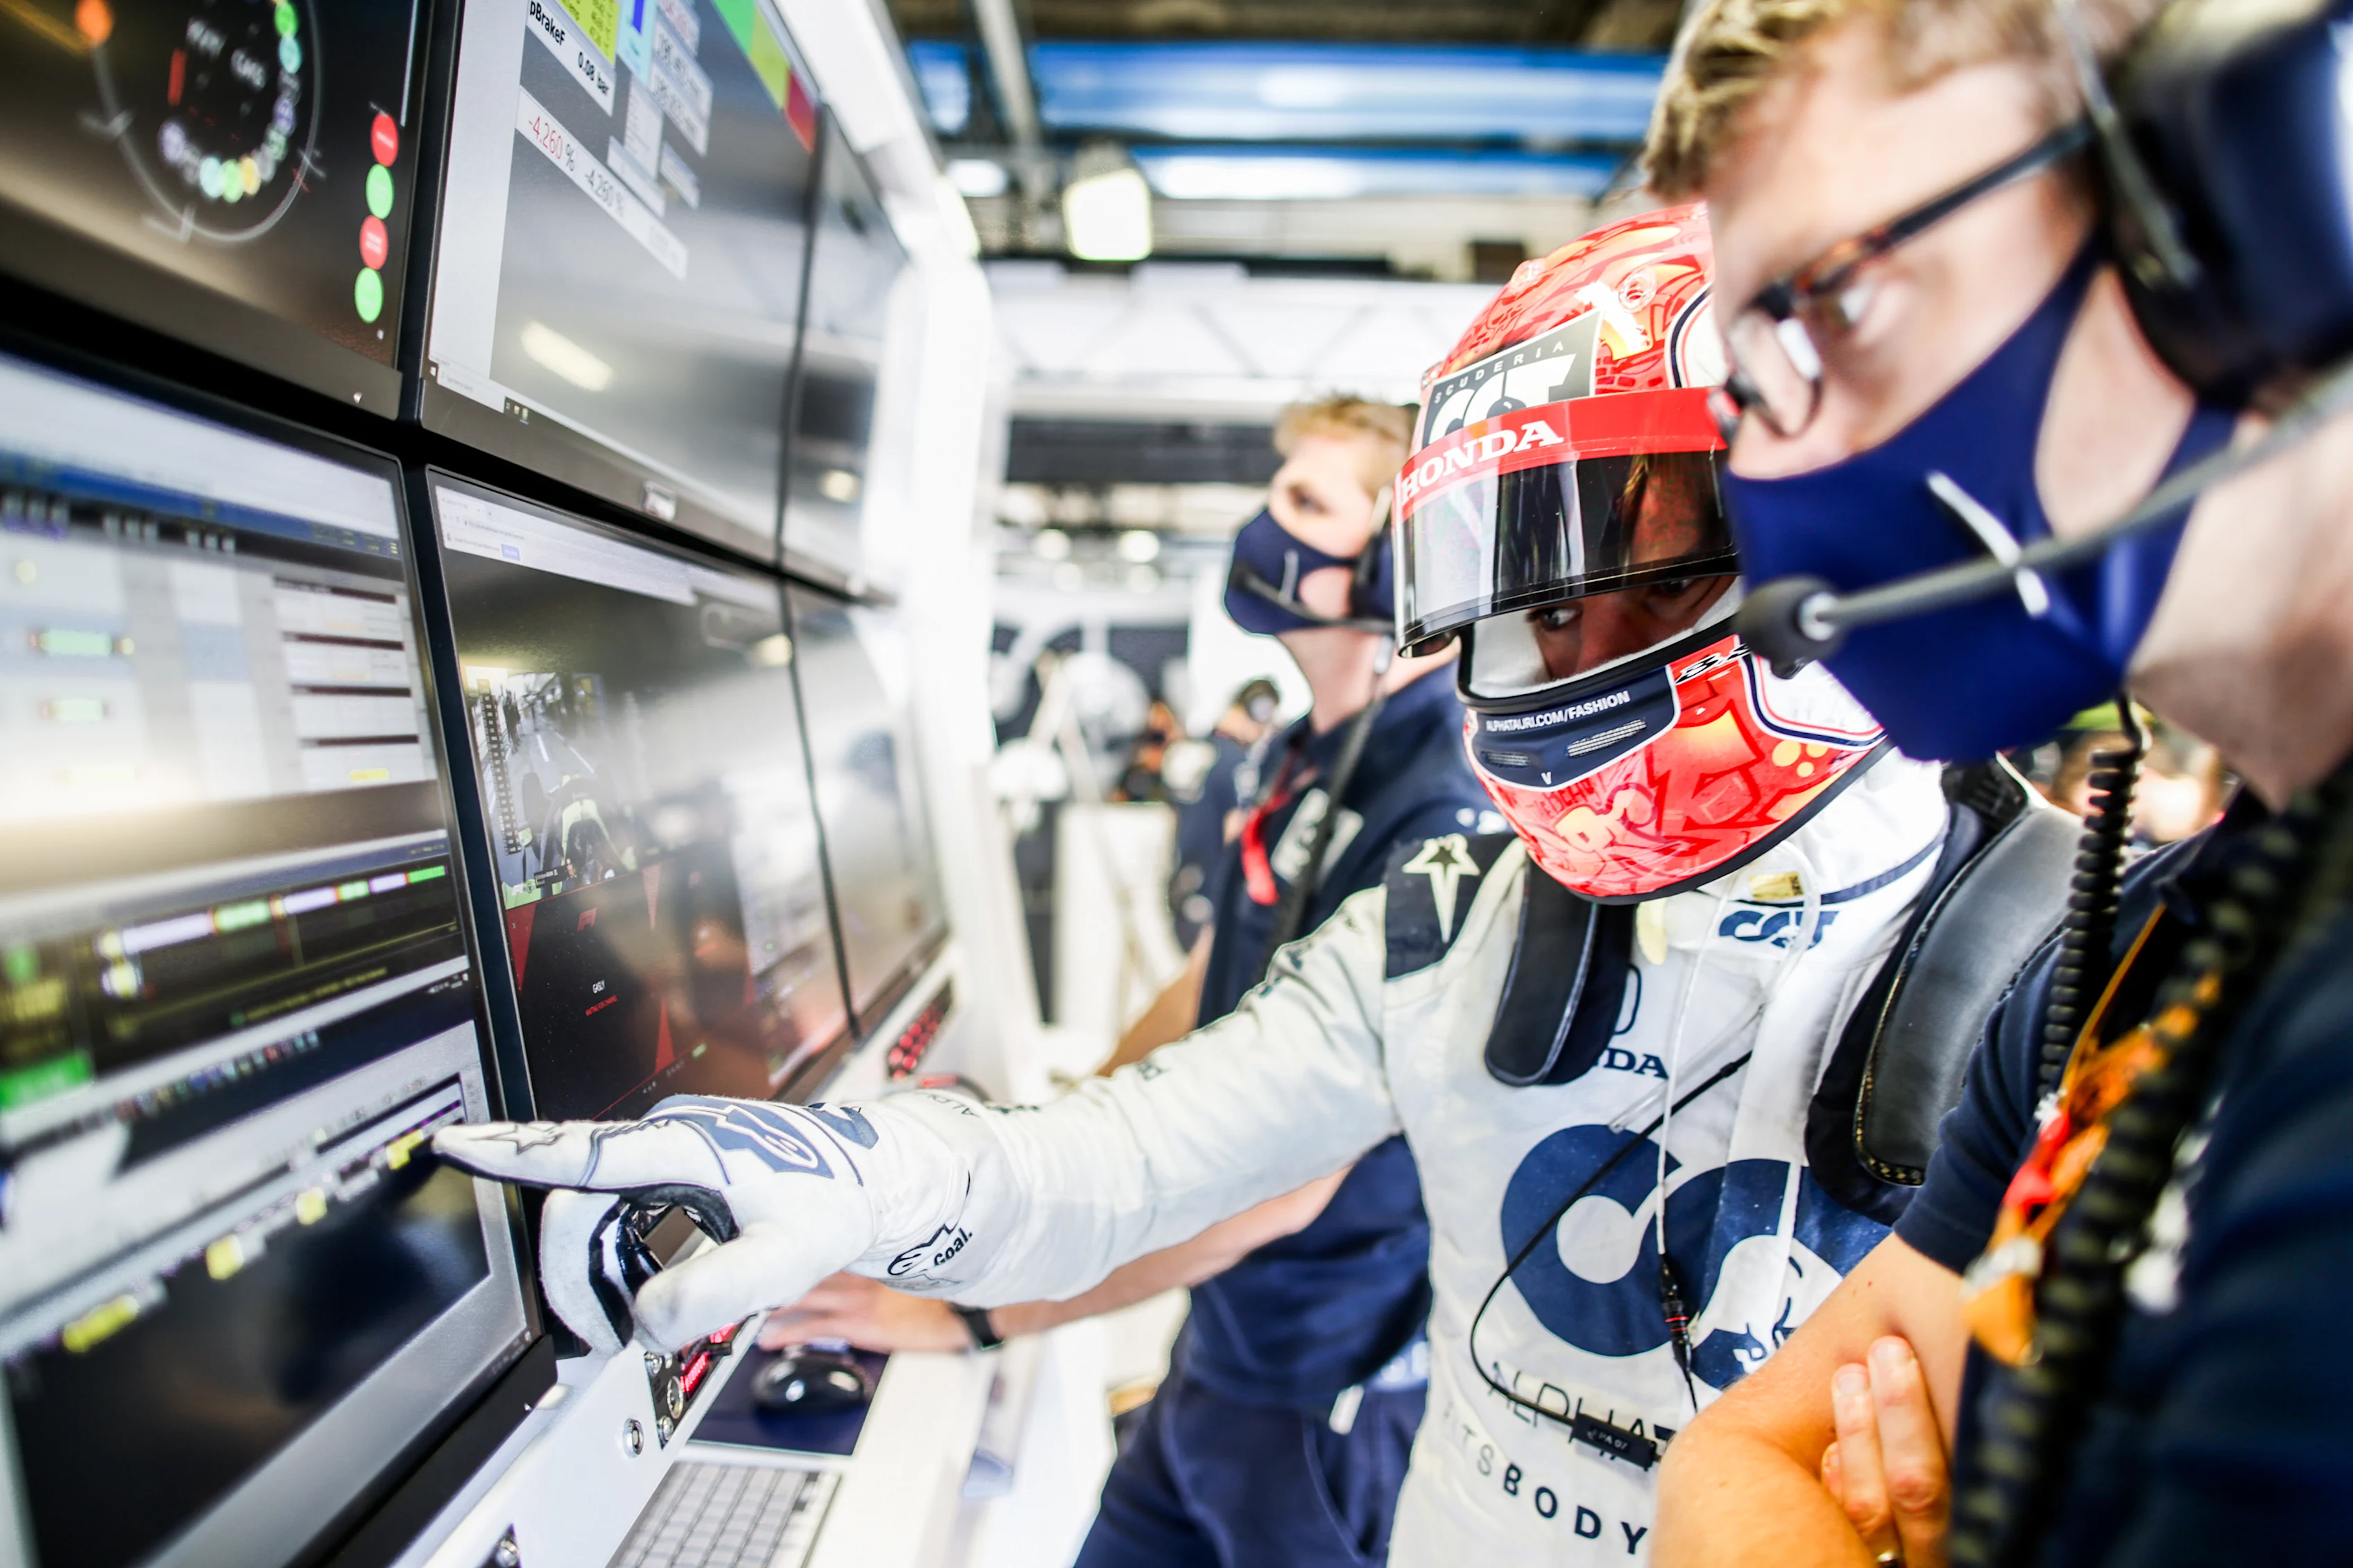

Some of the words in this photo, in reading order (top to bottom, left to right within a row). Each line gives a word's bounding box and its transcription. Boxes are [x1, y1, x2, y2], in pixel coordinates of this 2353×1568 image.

[529, 0, 565, 46] pBrakeF
[529, 115, 563, 160] -4.260
[565, 144, 575, 172] %
[1433, 341, 1564, 404] SCUDERIA
[1399, 420, 1564, 507] HONDA
[1485, 689, 1631, 732] ALPHATAURI.COM/FASHION
[1602, 1046, 1670, 1080] DA
[934, 1227, 973, 1267] Goal.
